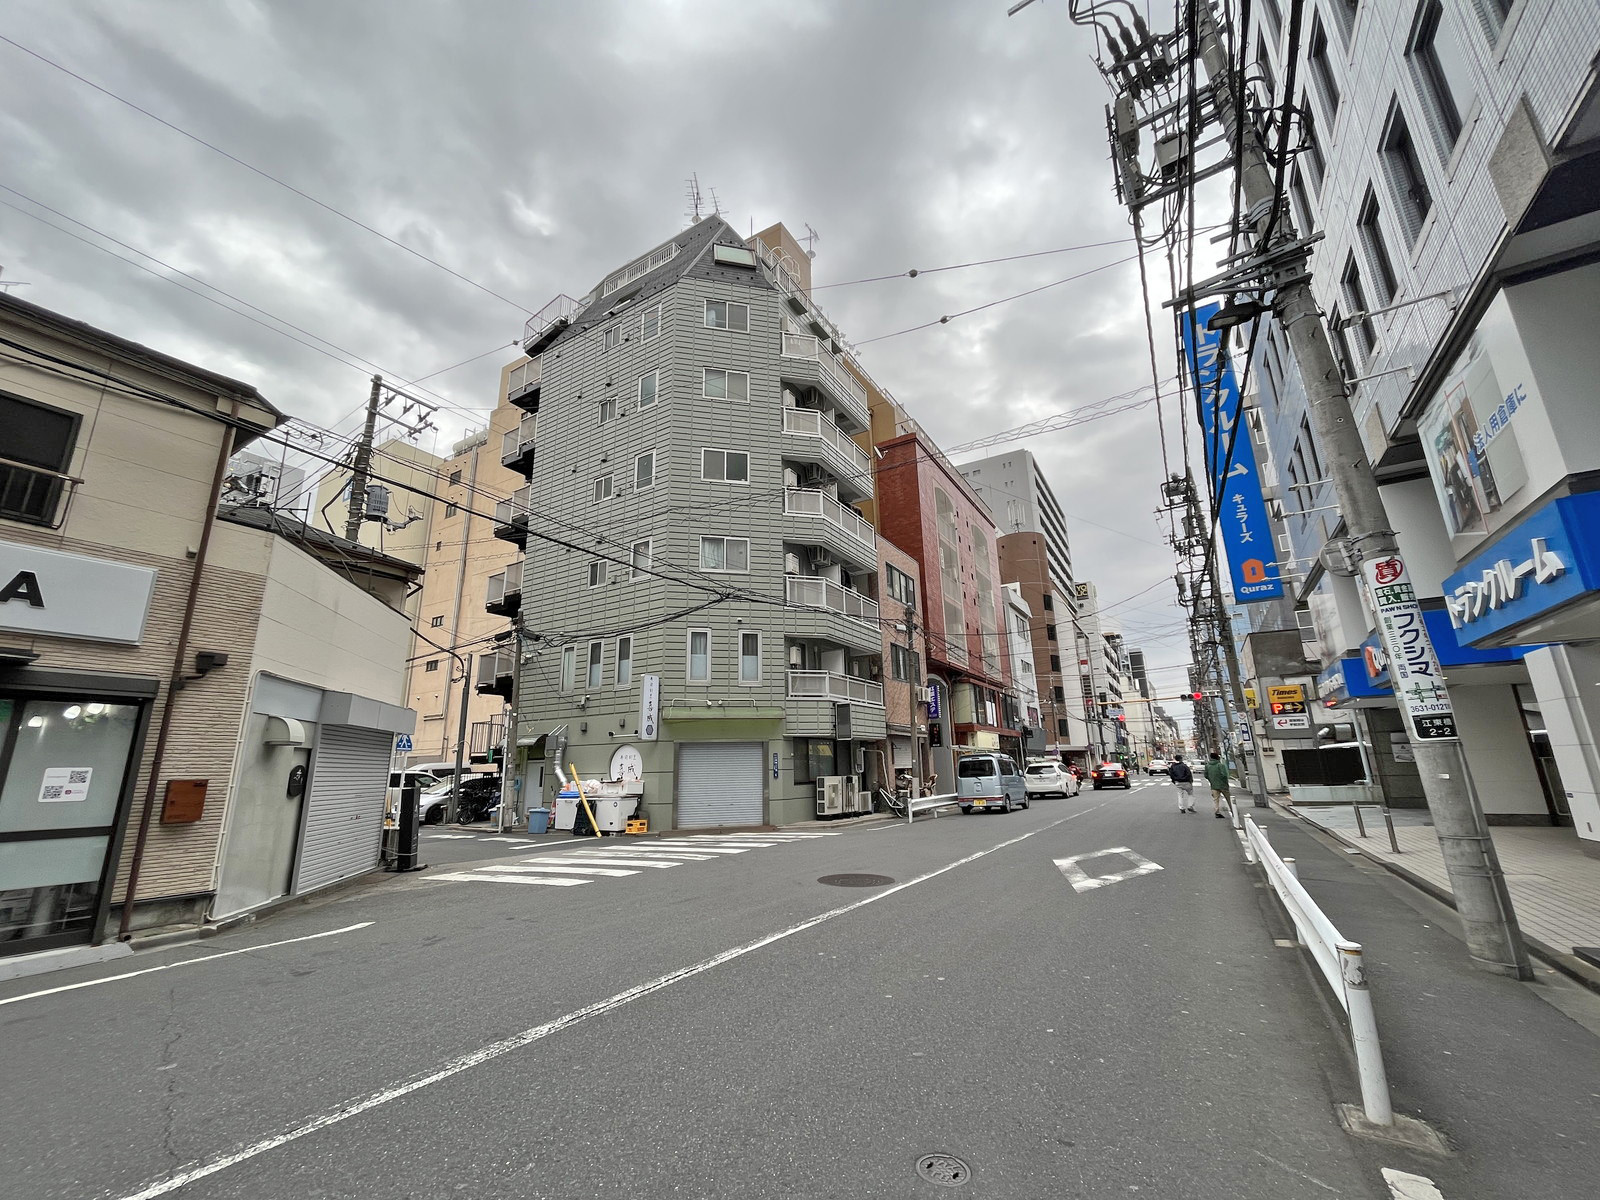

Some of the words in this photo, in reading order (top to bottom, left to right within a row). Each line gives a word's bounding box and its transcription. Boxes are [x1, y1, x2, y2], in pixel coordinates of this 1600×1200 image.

[1196, 323, 1249, 480] トランクルーム
[1473, 383, 1527, 455] 法人用倉庫に
[1232, 493, 1254, 544] キュラーズ
[1375, 558, 1403, 584] 質
[1240, 584, 1275, 595] Quraz
[1445, 537, 1566, 630] トランクルーム
[1381, 605, 1402, 613] PAWN
[1403, 603, 1418, 611] SHO
[1393, 612, 1434, 677] フクシマ
[1272, 703, 1284, 714] P
[1410, 703, 1448, 713] 3631-0121
[1421, 717, 1453, 727] 江東橋
[1429, 727, 1452, 736] 2-2
